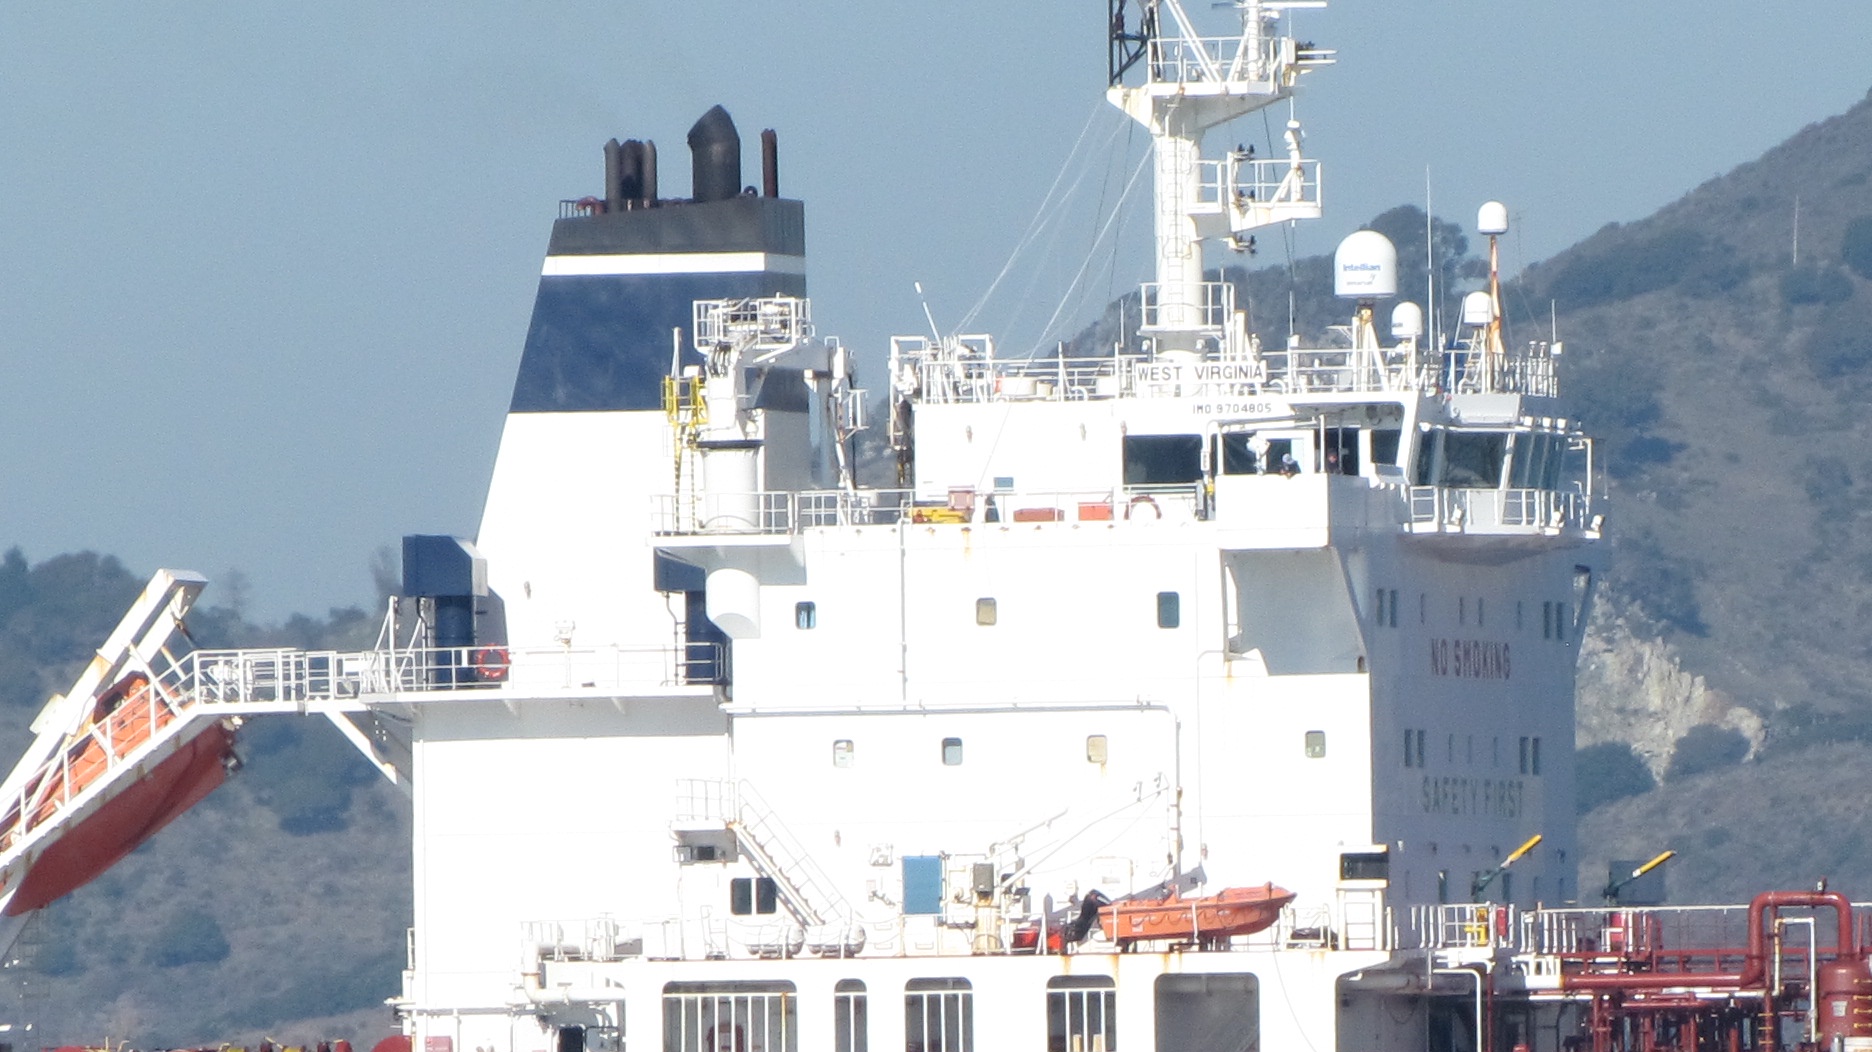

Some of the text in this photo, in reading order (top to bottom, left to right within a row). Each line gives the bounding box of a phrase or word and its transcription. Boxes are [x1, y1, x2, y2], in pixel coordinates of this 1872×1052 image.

[1138, 365, 1264, 381] WEST VIRGINIA
[1193, 404, 1211, 414] IMO
[1432, 639, 1511, 680] NO SMOKING
[1422, 775, 1524, 818] SAFETY FIRST
